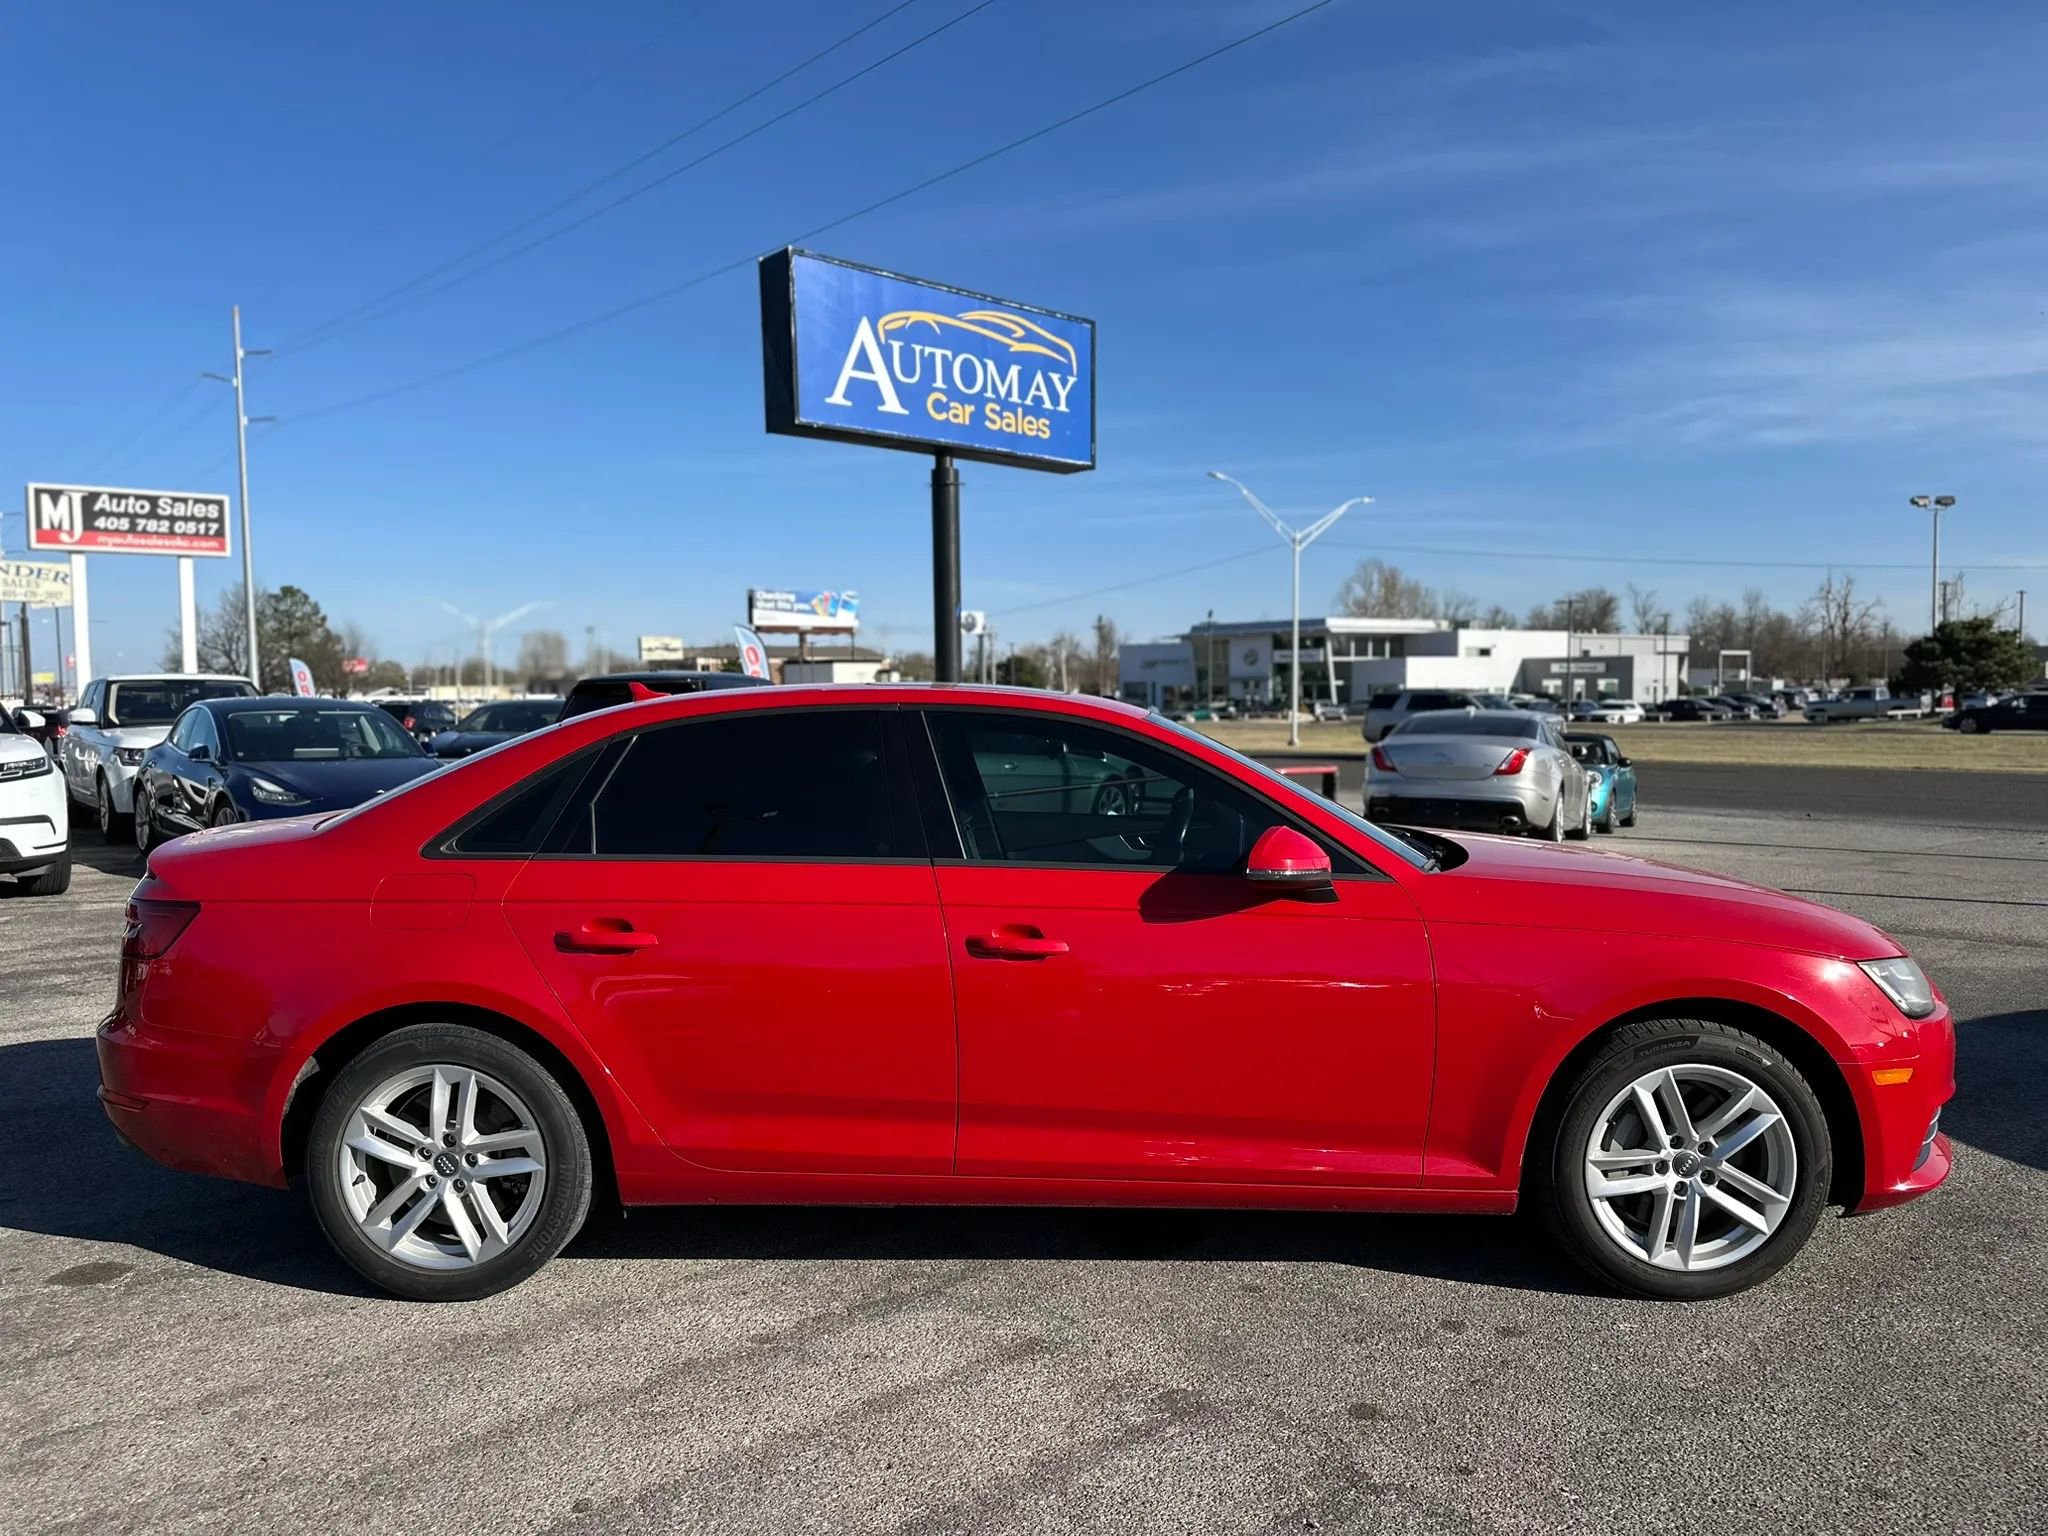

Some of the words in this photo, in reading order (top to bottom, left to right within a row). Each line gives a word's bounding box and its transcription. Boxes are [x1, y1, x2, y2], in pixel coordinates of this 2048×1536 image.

[824, 316, 1078, 415] AUTOMAY
[926, 391, 975, 426] Car
[984, 402, 1051, 440] Sales
[40, 491, 88, 543] MJ
[93, 493, 150, 514] Auto
[157, 497, 219, 518] Sales
[94, 516, 130, 531] 405
[135, 518, 169, 534] 782
[174, 520, 219, 536] 0517
[2, 577, 40, 589] SALES
